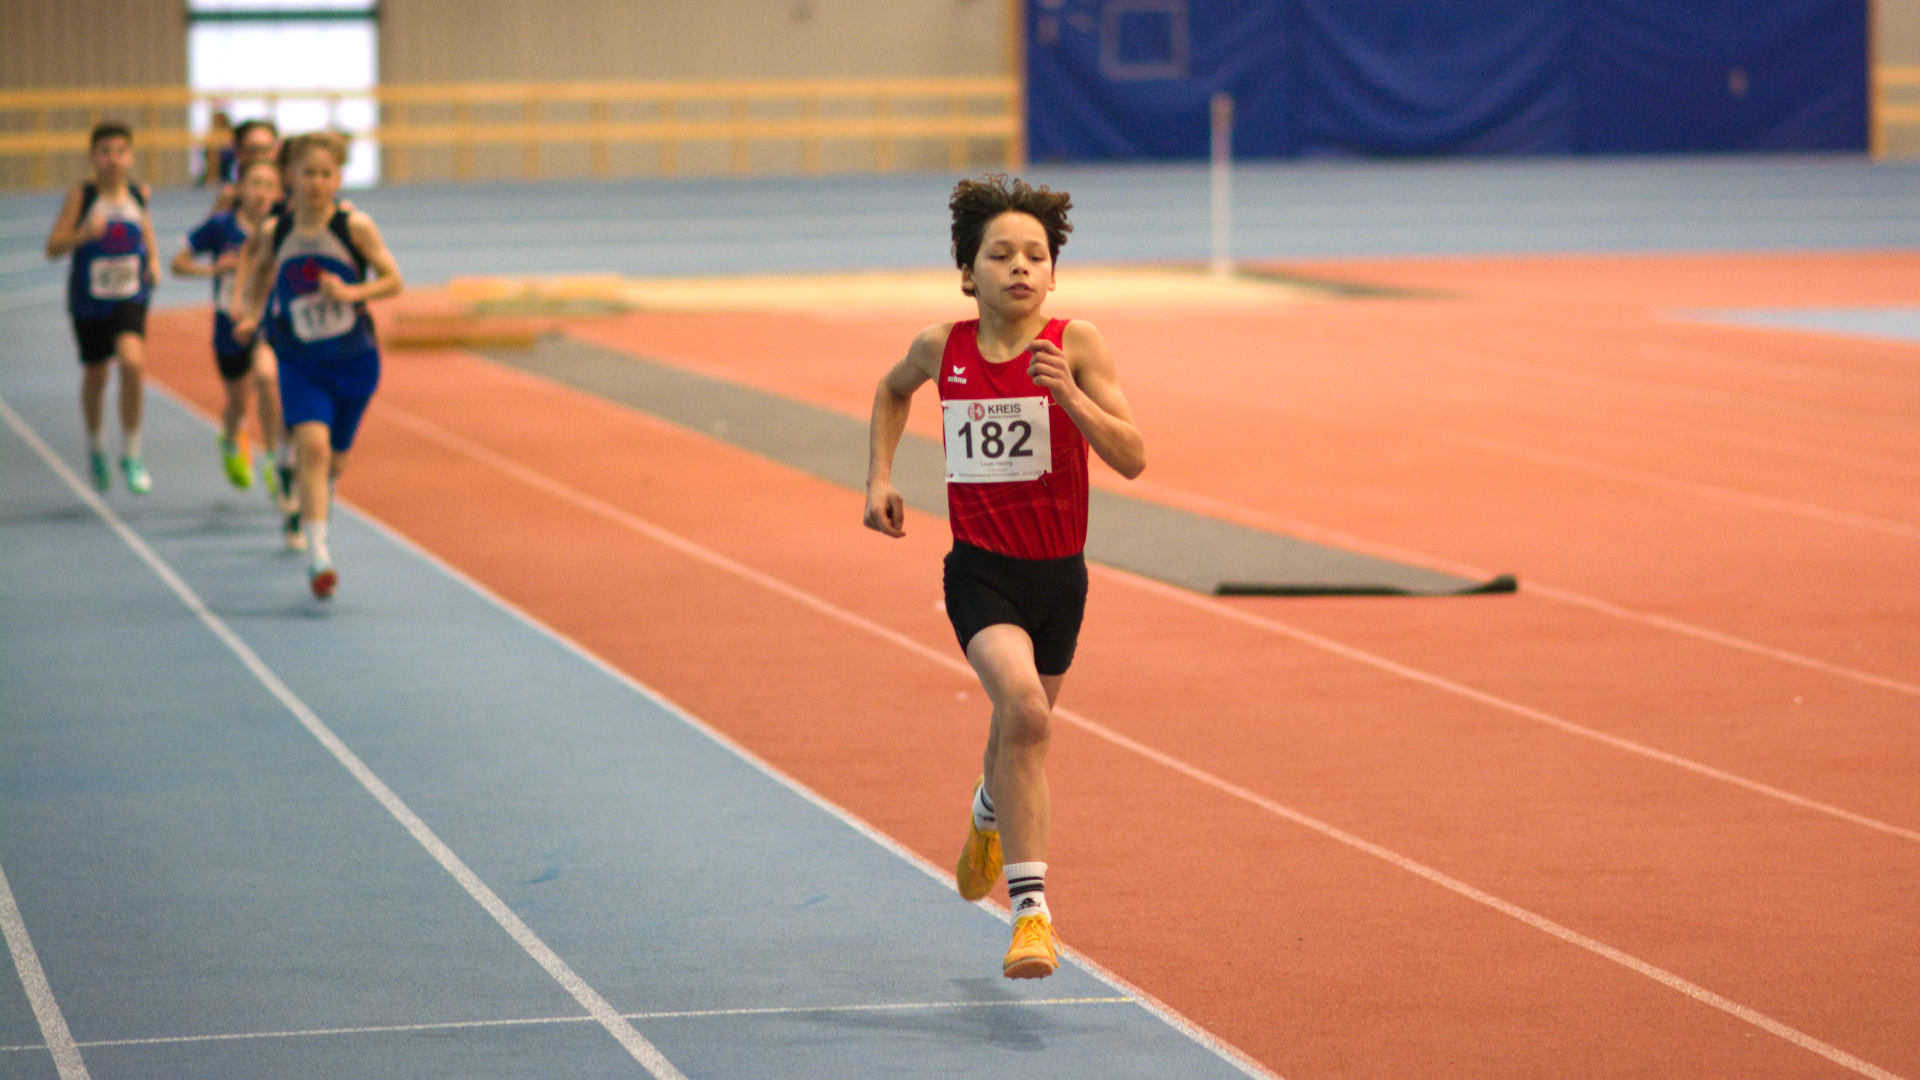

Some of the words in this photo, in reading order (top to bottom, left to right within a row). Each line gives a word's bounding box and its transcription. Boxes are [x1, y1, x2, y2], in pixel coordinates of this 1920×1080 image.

[948, 376, 967, 384] erima
[988, 403, 1021, 414] KREIS
[958, 420, 1033, 458] 182
